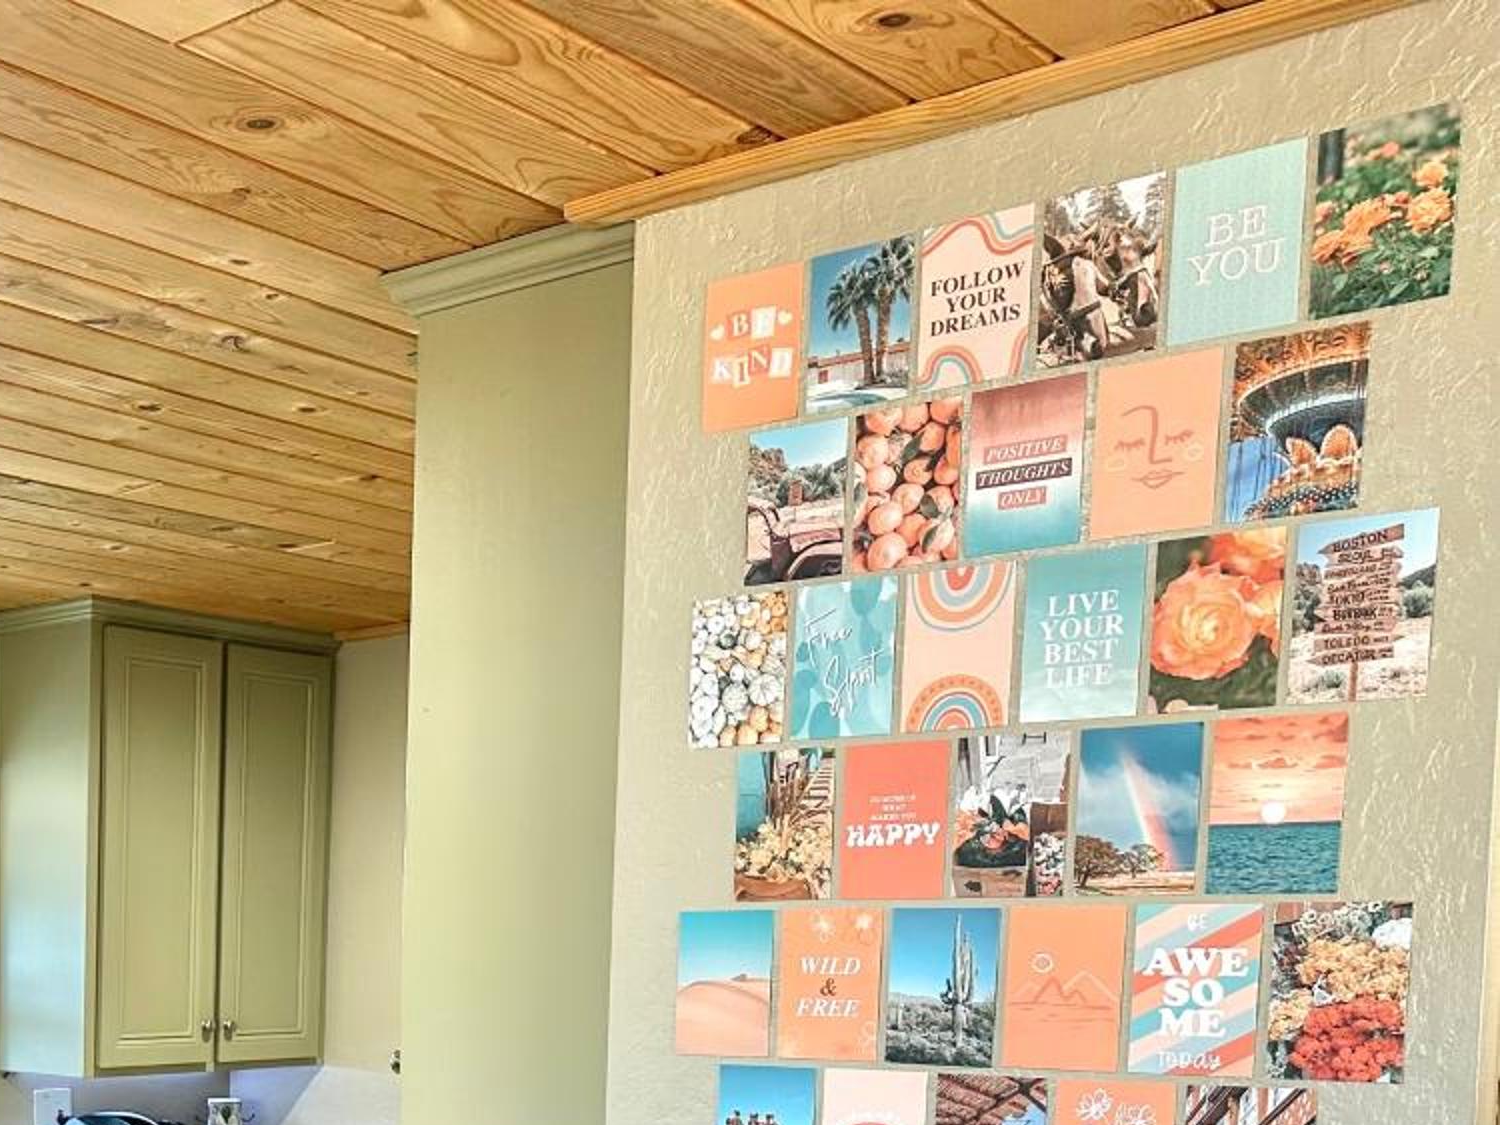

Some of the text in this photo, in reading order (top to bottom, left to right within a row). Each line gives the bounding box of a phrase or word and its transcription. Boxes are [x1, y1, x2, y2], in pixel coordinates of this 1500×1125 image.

[1204, 204, 1268, 249] BE
[1187, 237, 1285, 287] YOU
[930, 260, 1025, 297] FOLLOW
[945, 286, 1007, 314] YOUR
[731, 307, 775, 338] BE
[930, 304, 1021, 337] DREAMS
[711, 347, 792, 386] KIND
[985, 436, 1064, 462] POSITIVE
[977, 460, 1070, 487] THOUGHTS
[998, 488, 1046, 509] ONLY
[1332, 529, 1388, 553] BOSTON
[1048, 589, 1119, 618] LIVE
[1038, 614, 1124, 643] YOUR
[1324, 635, 1370, 649] TOLEDO
[1044, 638, 1119, 665] BEST
[1047, 663, 1112, 690] LIFE
[846, 822, 940, 848] HAPPY
[801, 956, 861, 976] WILD
[1143, 947, 1249, 977] AWE
[820, 978, 837, 997] &
[1163, 977, 1224, 1007] SO
[796, 999, 860, 1018] FREE
[1158, 1007, 1226, 1037] ME
